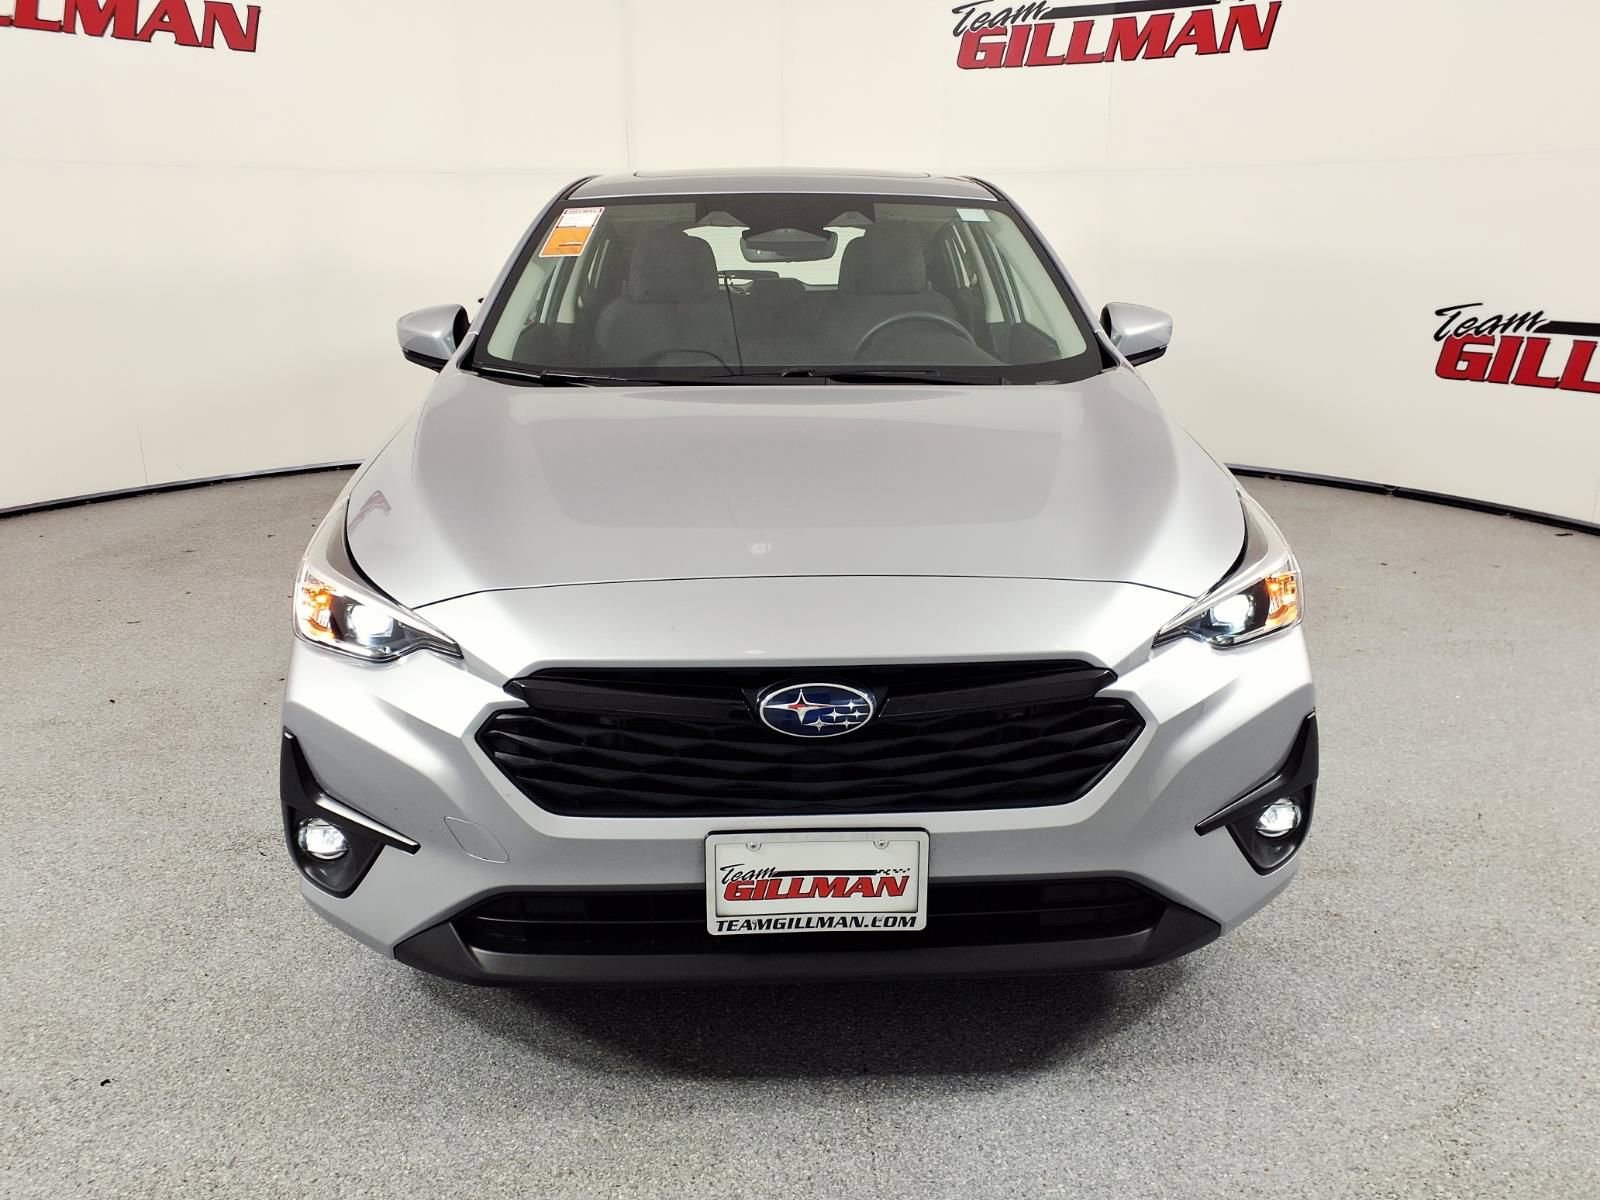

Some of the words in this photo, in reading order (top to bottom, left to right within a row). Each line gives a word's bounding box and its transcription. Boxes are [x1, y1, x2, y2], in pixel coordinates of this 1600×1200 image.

[952, 0, 1051, 37] Team
[957, 1, 1282, 69] GILLMAN
[1434, 303, 1548, 342] Team
[720, 864, 776, 884] Team
[724, 876, 909, 901] GILLMAN
[716, 916, 917, 932] TEAMGILLMAN.COM
